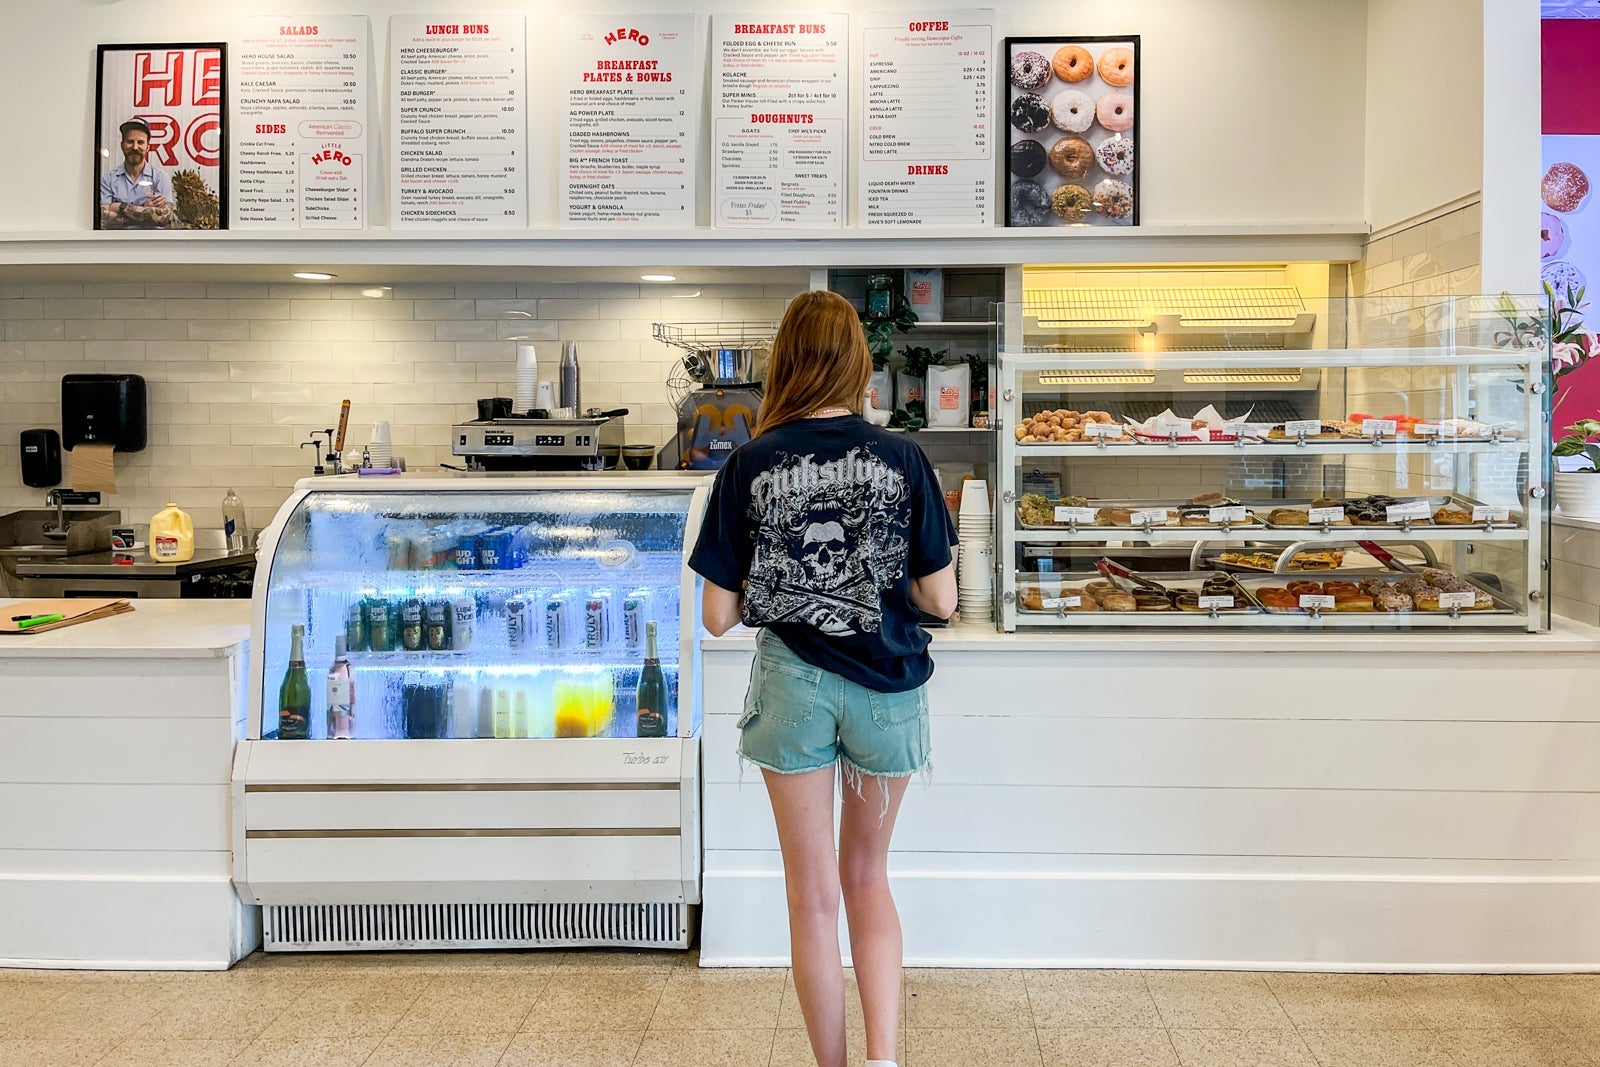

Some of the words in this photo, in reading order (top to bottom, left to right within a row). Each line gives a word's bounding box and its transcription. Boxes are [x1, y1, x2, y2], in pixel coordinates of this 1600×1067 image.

[280, 26, 318, 35] SALADS
[426, 25, 459, 34] LUNCH
[463, 25, 489, 34] BUNS
[735, 24, 795, 34] BREAKFAST
[799, 24, 826, 34] BUNS
[909, 22, 948, 31] COFFEE
[604, 28, 649, 46] HERO
[597, 61, 658, 69] BREAKFAST
[134, 48, 220, 107] HE
[583, 73, 622, 82] PLATES
[626, 73, 633, 82] &
[637, 73, 672, 82] BOWLS
[751, 114, 813, 123] DOUGHNUTS
[256, 125, 286, 133] SIDES
[312, 150, 351, 166] HERO
[908, 165, 948, 175] DRINKS
[587, 613, 596, 647] TRULY
